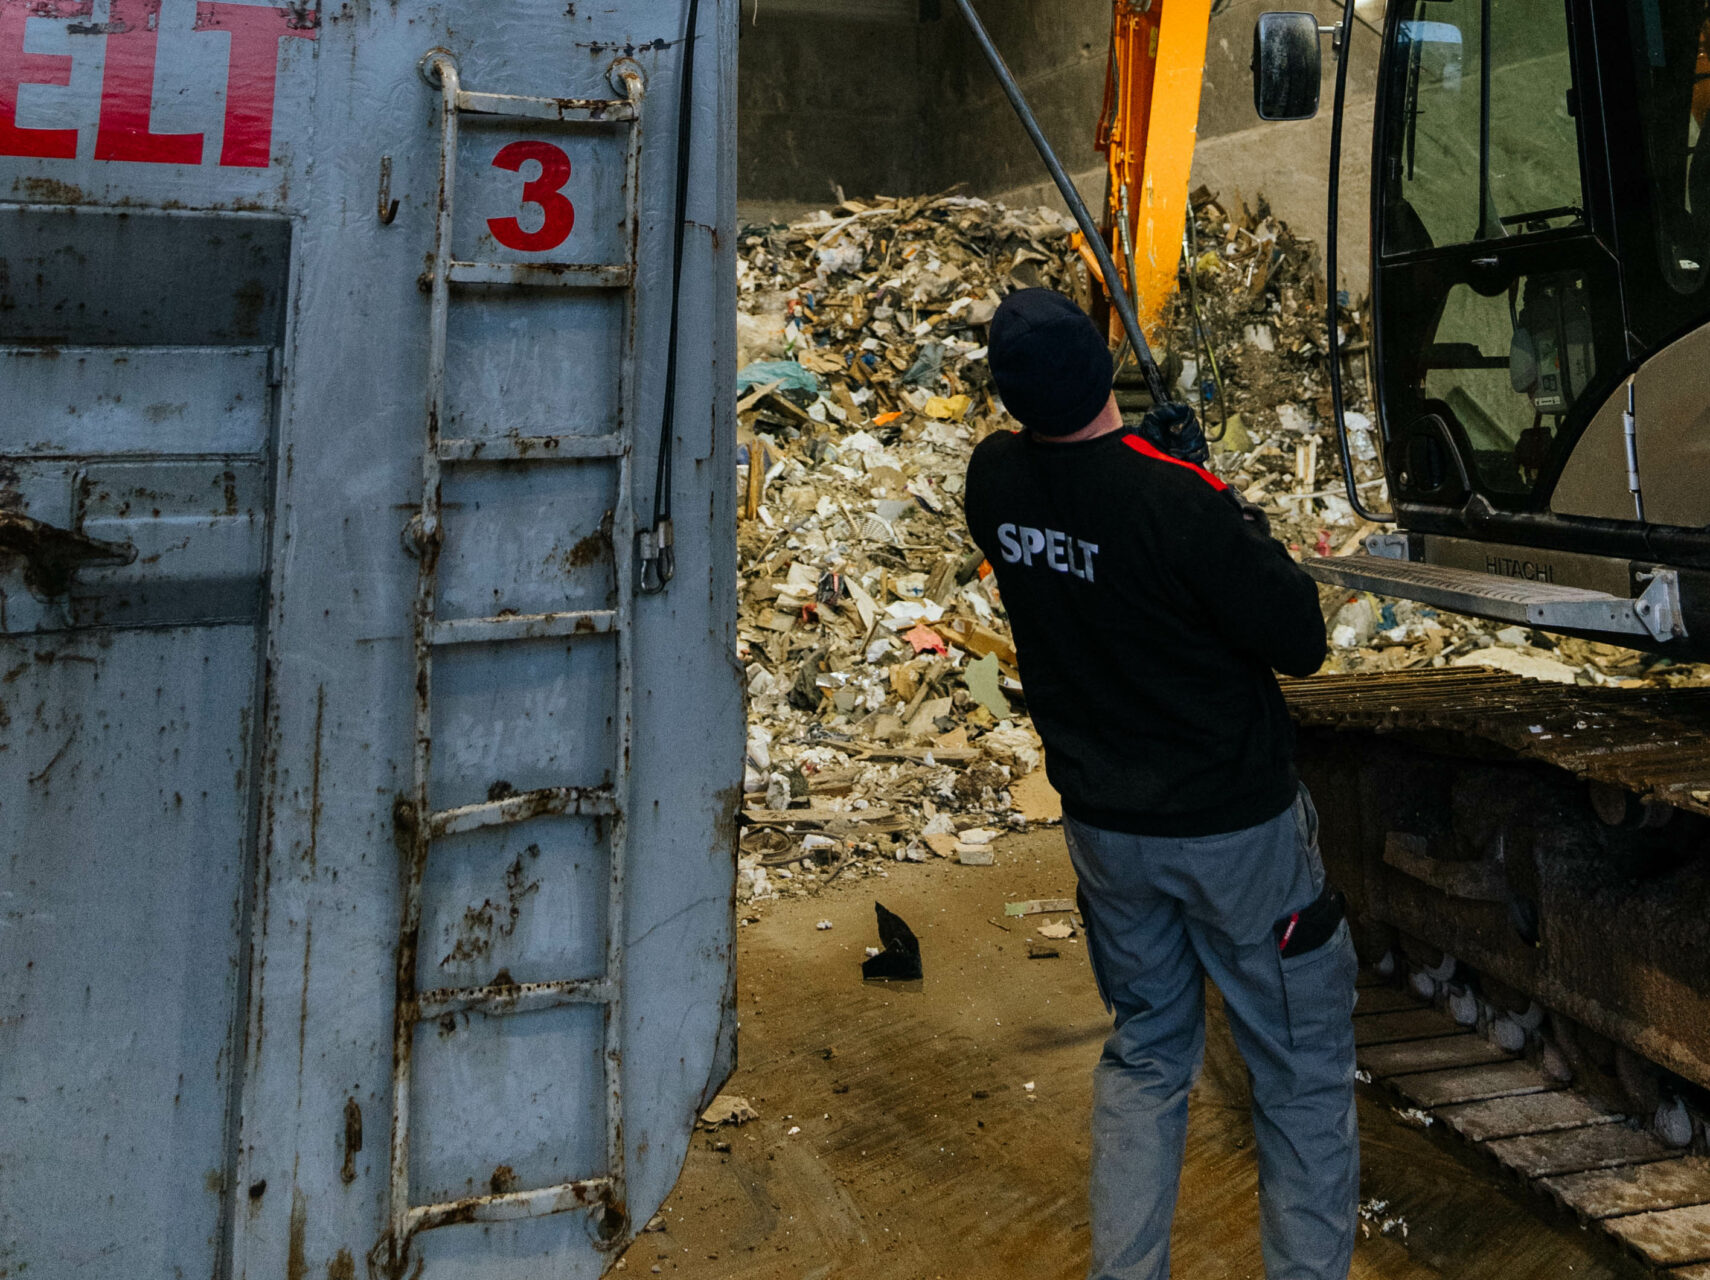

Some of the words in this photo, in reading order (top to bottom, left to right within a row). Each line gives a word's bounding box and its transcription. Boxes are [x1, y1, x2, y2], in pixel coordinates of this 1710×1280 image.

[486, 140, 575, 252] 3
[997, 522, 1099, 584] SPELT
[1486, 555, 1553, 583] HITACHI
